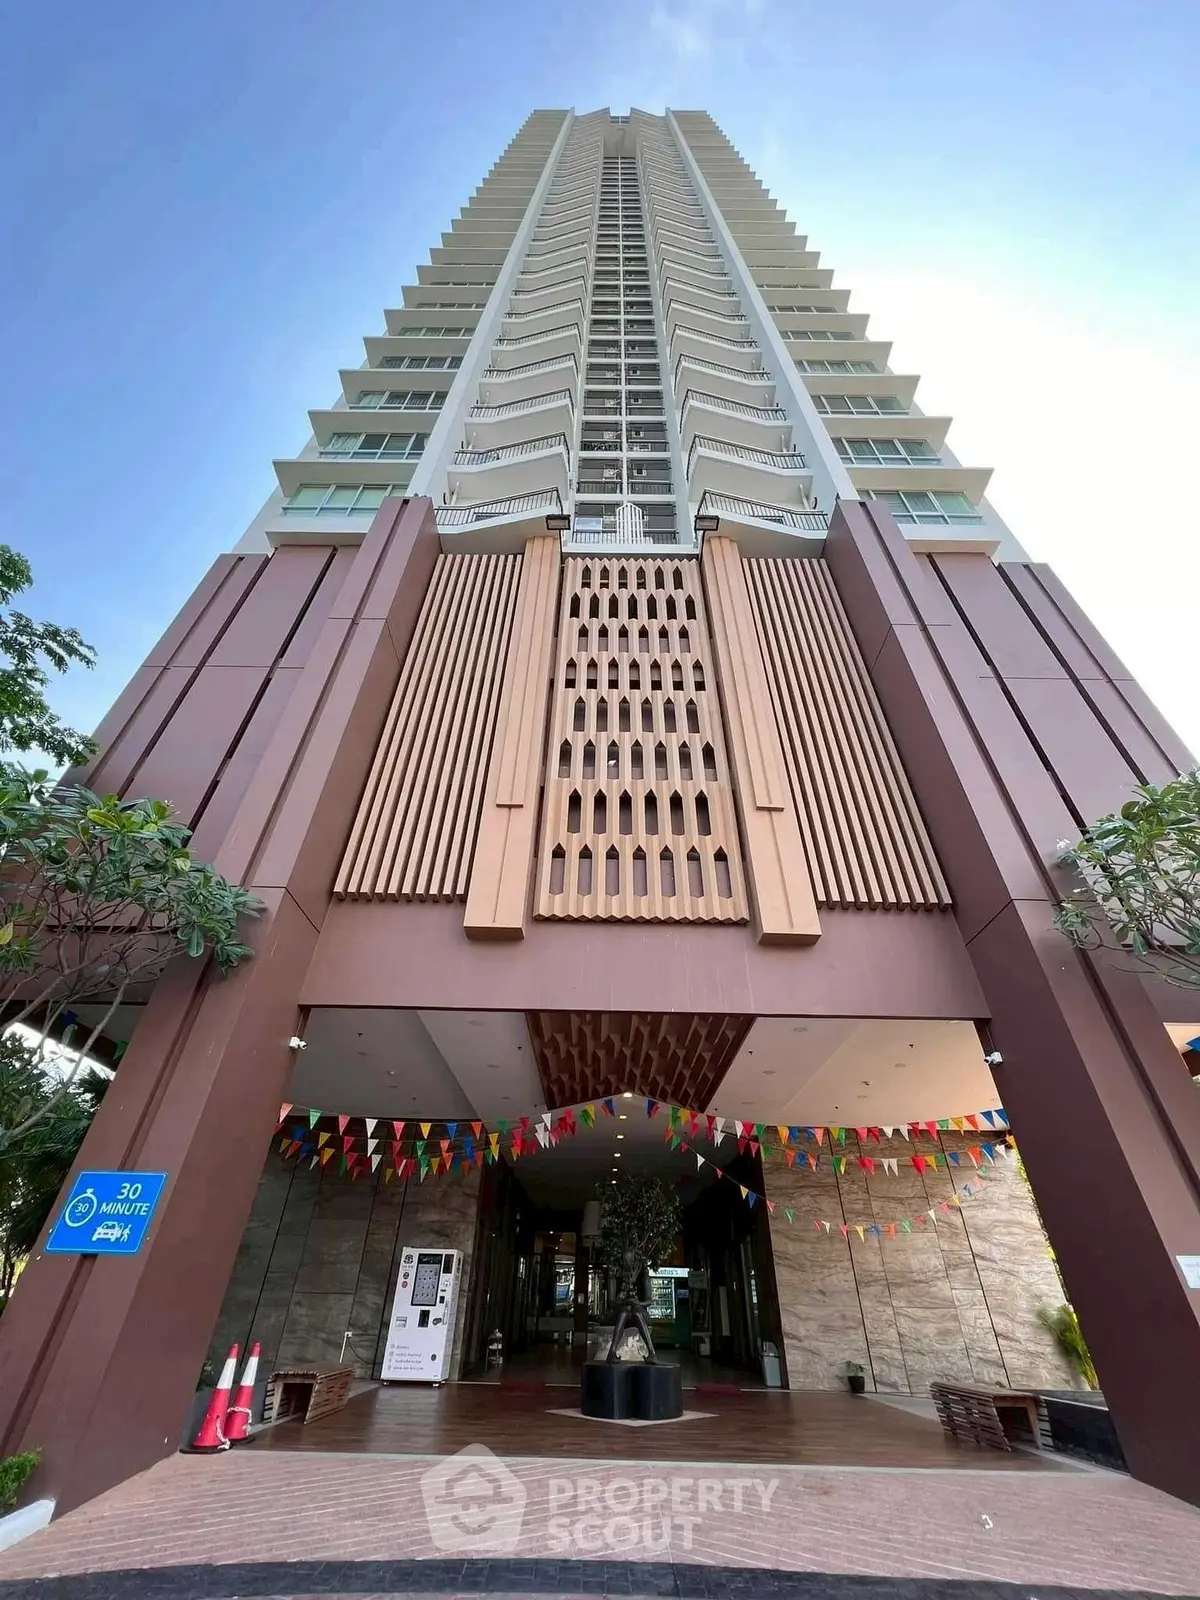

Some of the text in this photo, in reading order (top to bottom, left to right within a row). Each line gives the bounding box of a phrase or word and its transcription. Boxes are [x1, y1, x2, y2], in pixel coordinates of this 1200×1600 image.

[116, 1182, 142, 1200] 30
[75, 1203, 89, 1213] 30
[99, 1202, 151, 1216] MINUTE
